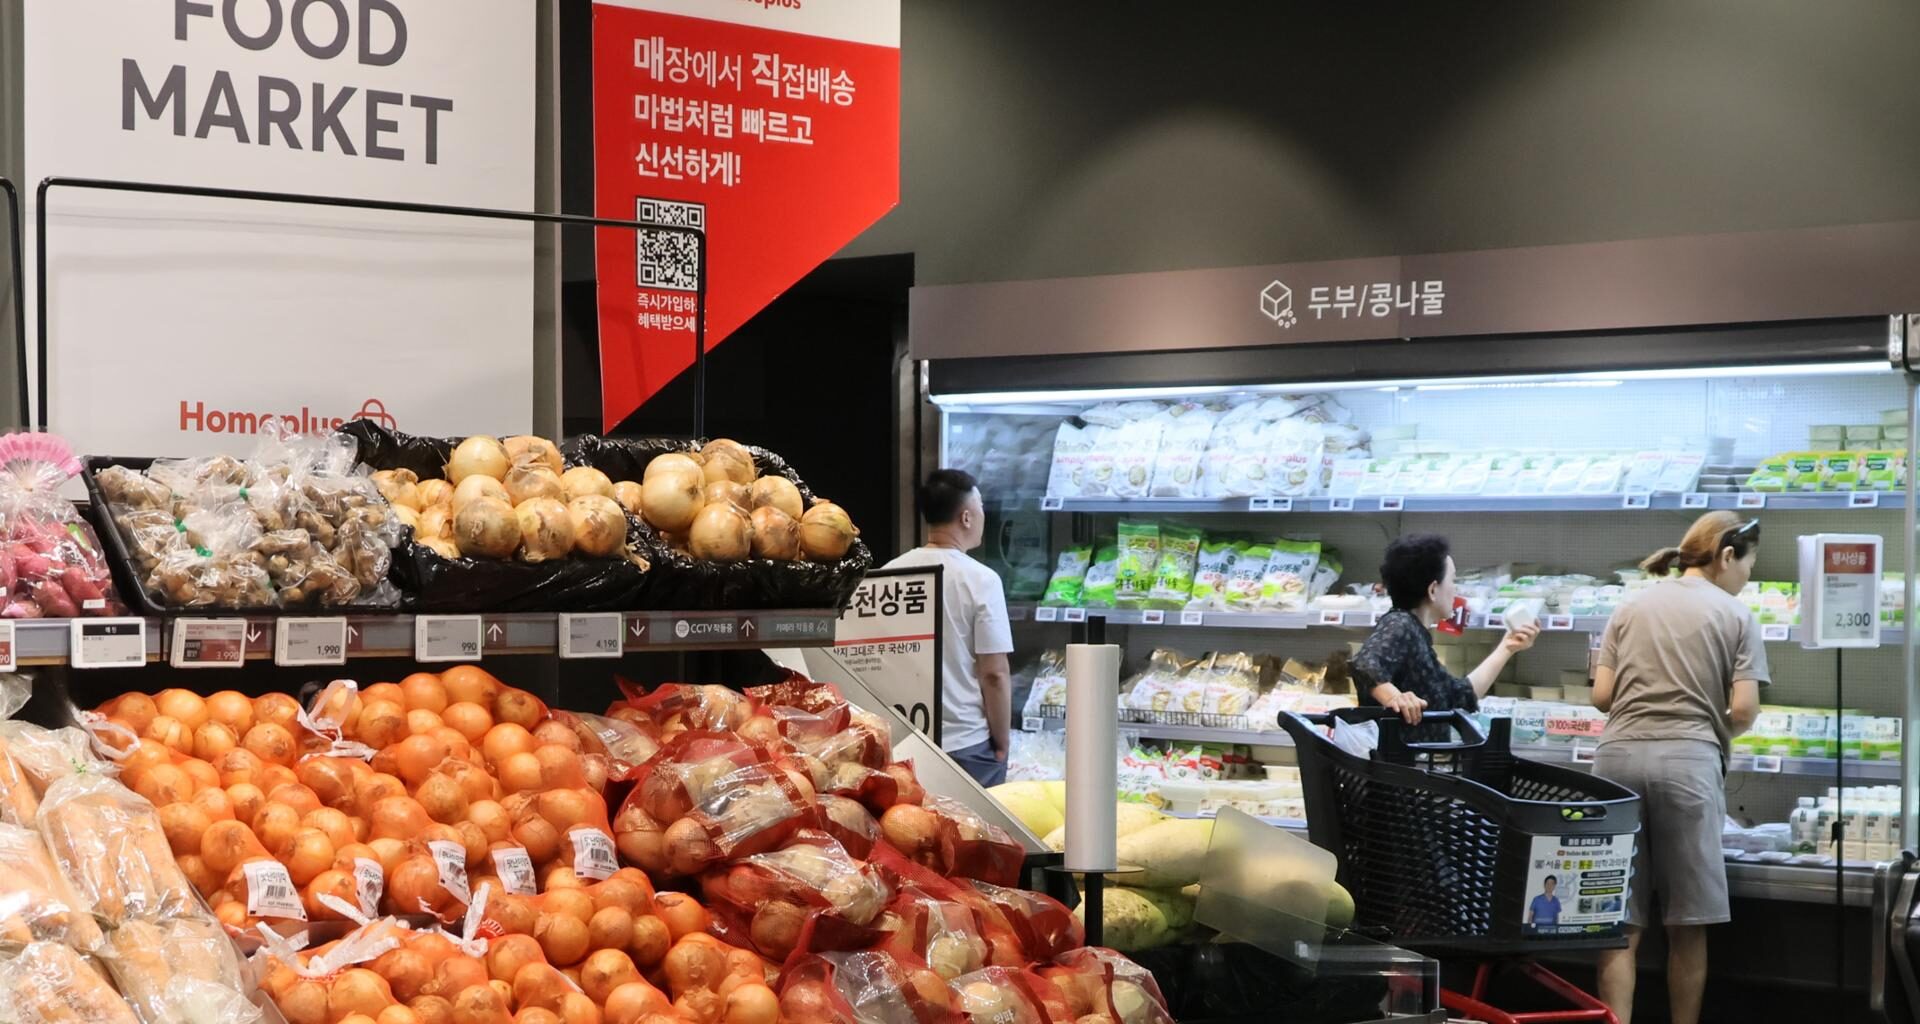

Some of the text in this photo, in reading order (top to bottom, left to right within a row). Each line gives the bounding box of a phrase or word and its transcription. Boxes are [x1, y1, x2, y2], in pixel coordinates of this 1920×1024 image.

[174, 0, 407, 67] FOOD
[634, 36, 856, 105] 매장에서 직접배송
[122, 58, 453, 165] MARKET
[634, 93, 815, 145] 마법처럼 빠르고
[635, 142, 742, 187] 신선하게!
[637, 292, 707, 313] 즉시가입하
[1308, 280, 1446, 320] 두부/콩나물
[638, 312, 707, 333] 혜택받으세
[1832, 551, 1867, 566] 행사상품
[1836, 612, 1871, 628] 2,300
[316, 645, 341, 656] 1,990
[461, 641, 478, 652] 990
[850, 645, 875, 656] 그대로
[878, 644, 886, 655] 무
